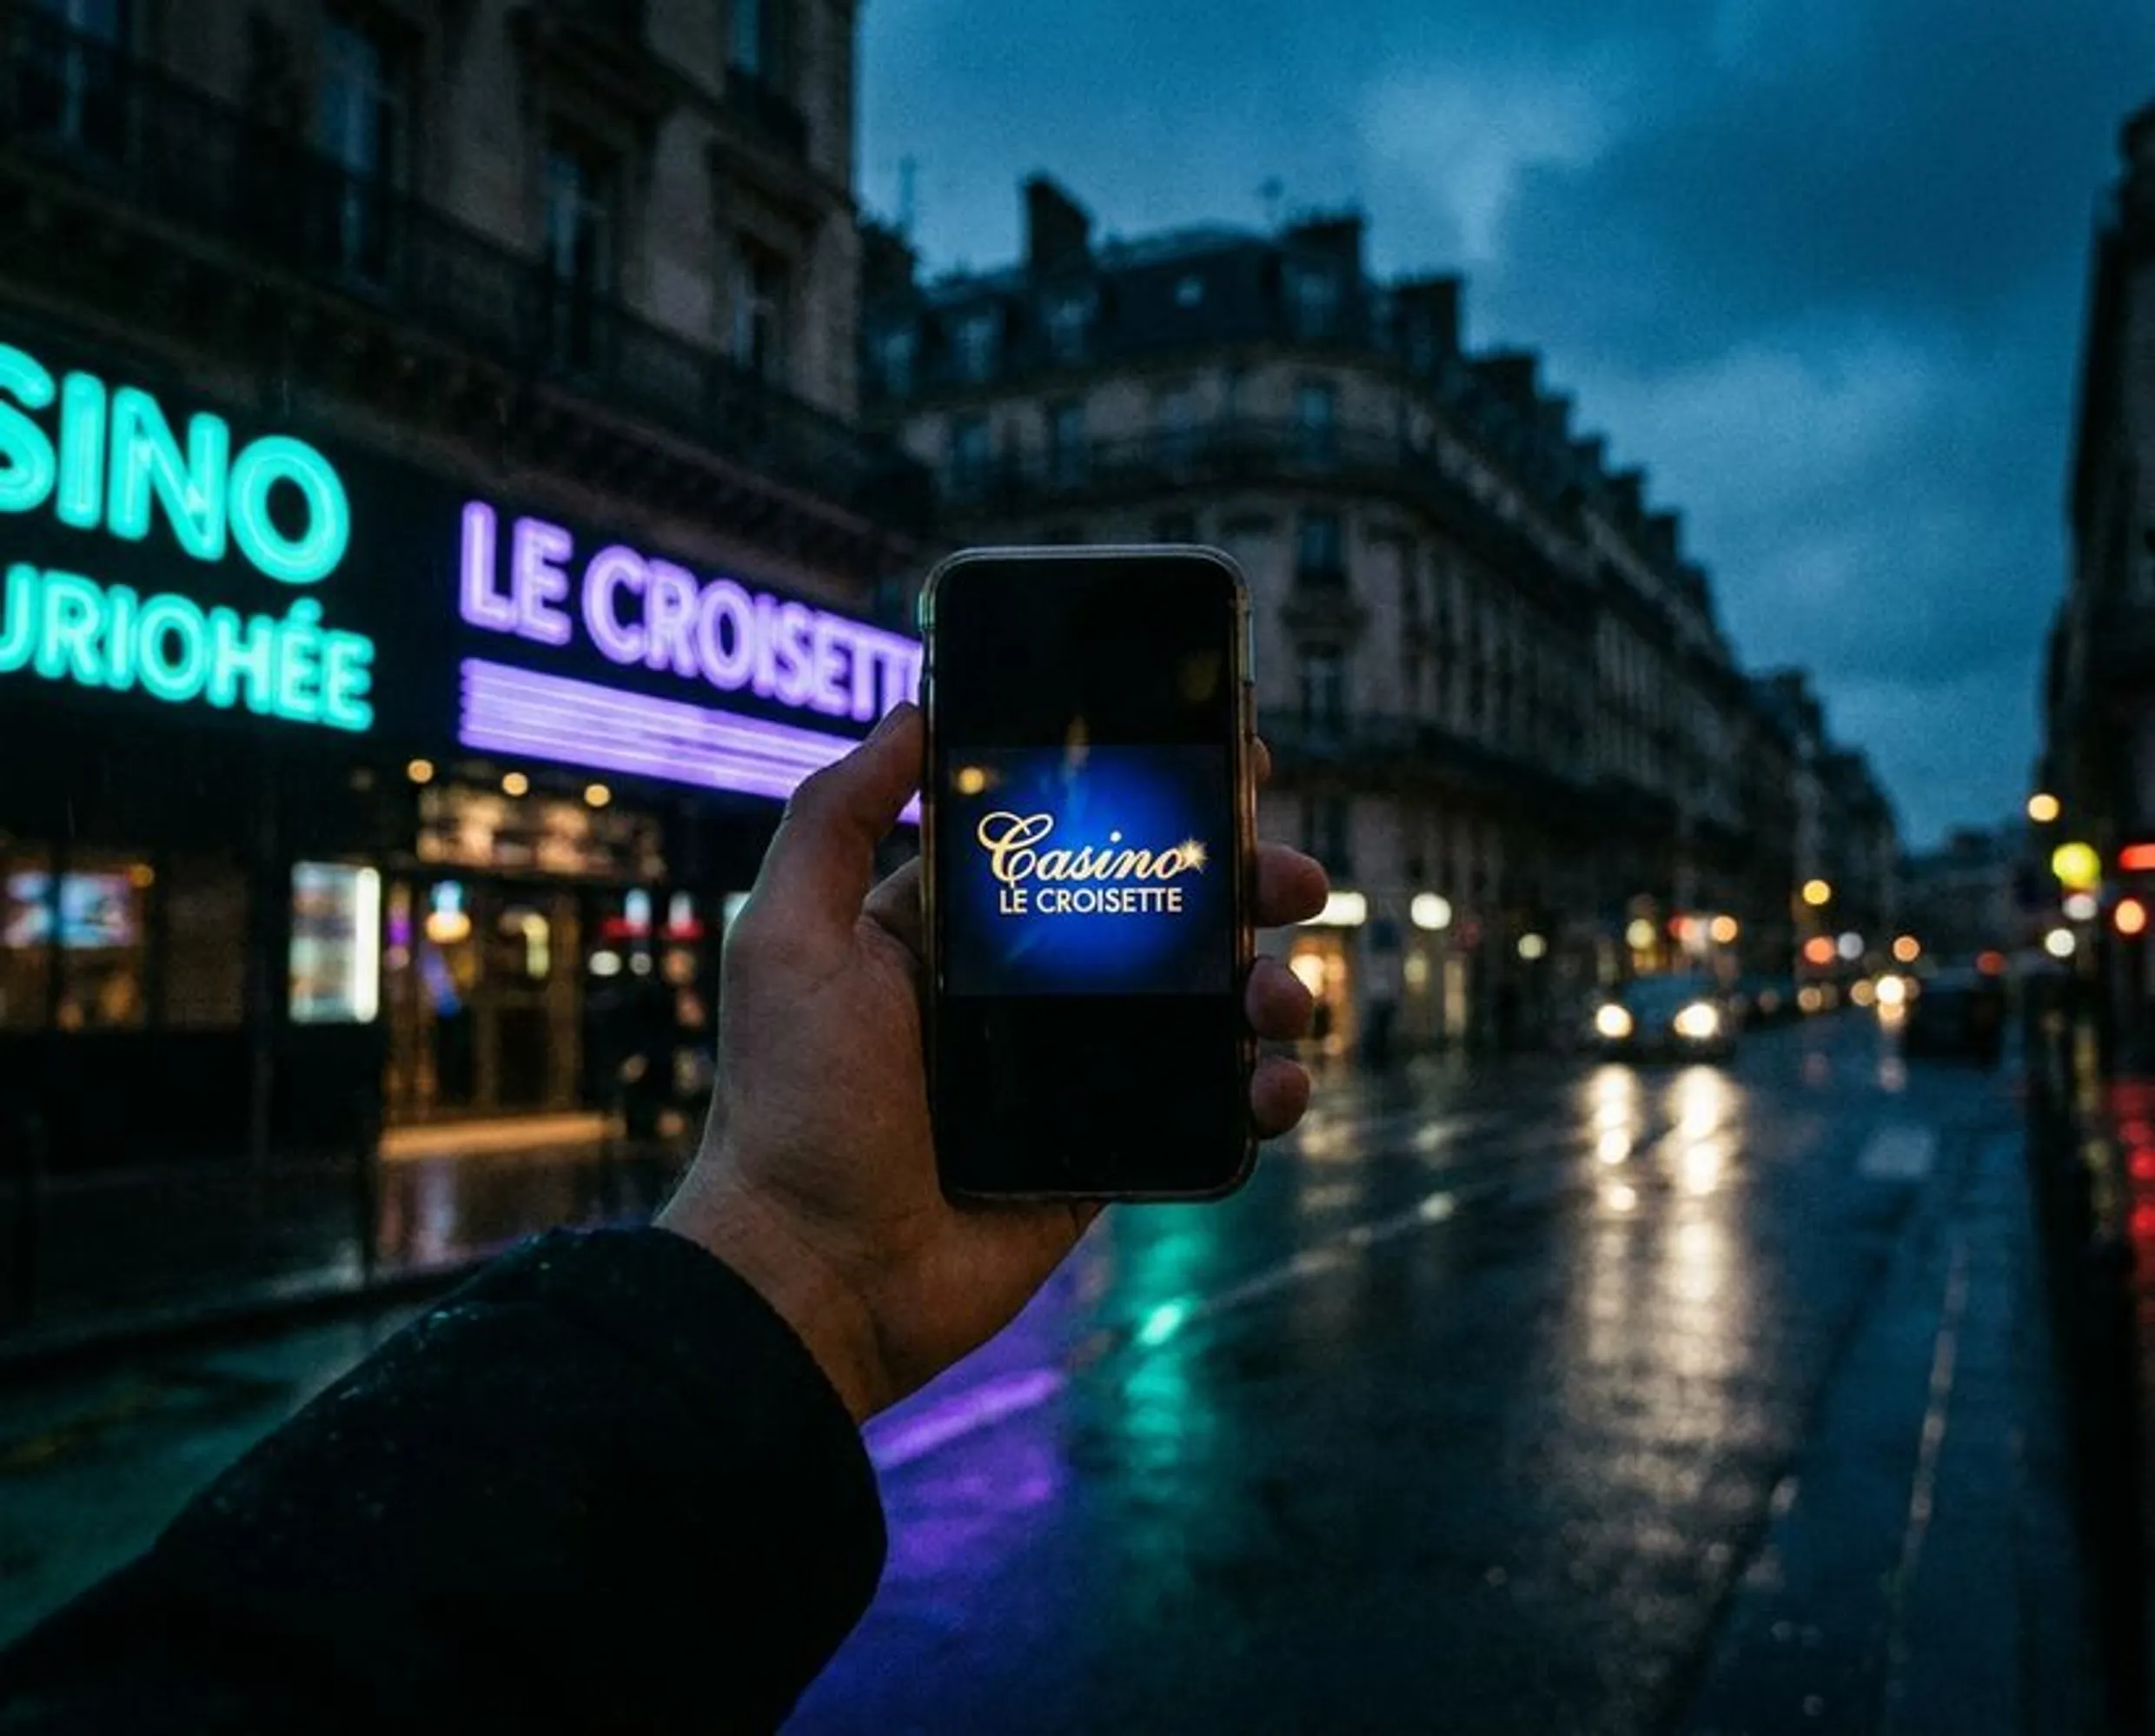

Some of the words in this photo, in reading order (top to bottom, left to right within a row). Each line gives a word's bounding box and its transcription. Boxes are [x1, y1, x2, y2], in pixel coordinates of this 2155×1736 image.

[461, 500, 573, 646] LE
[582, 545, 922, 721] CROISETT
[978, 812, 1189, 888] Casino
[1000, 890, 1028, 913] LE
[1037, 888, 1183, 913] CROISETTE
